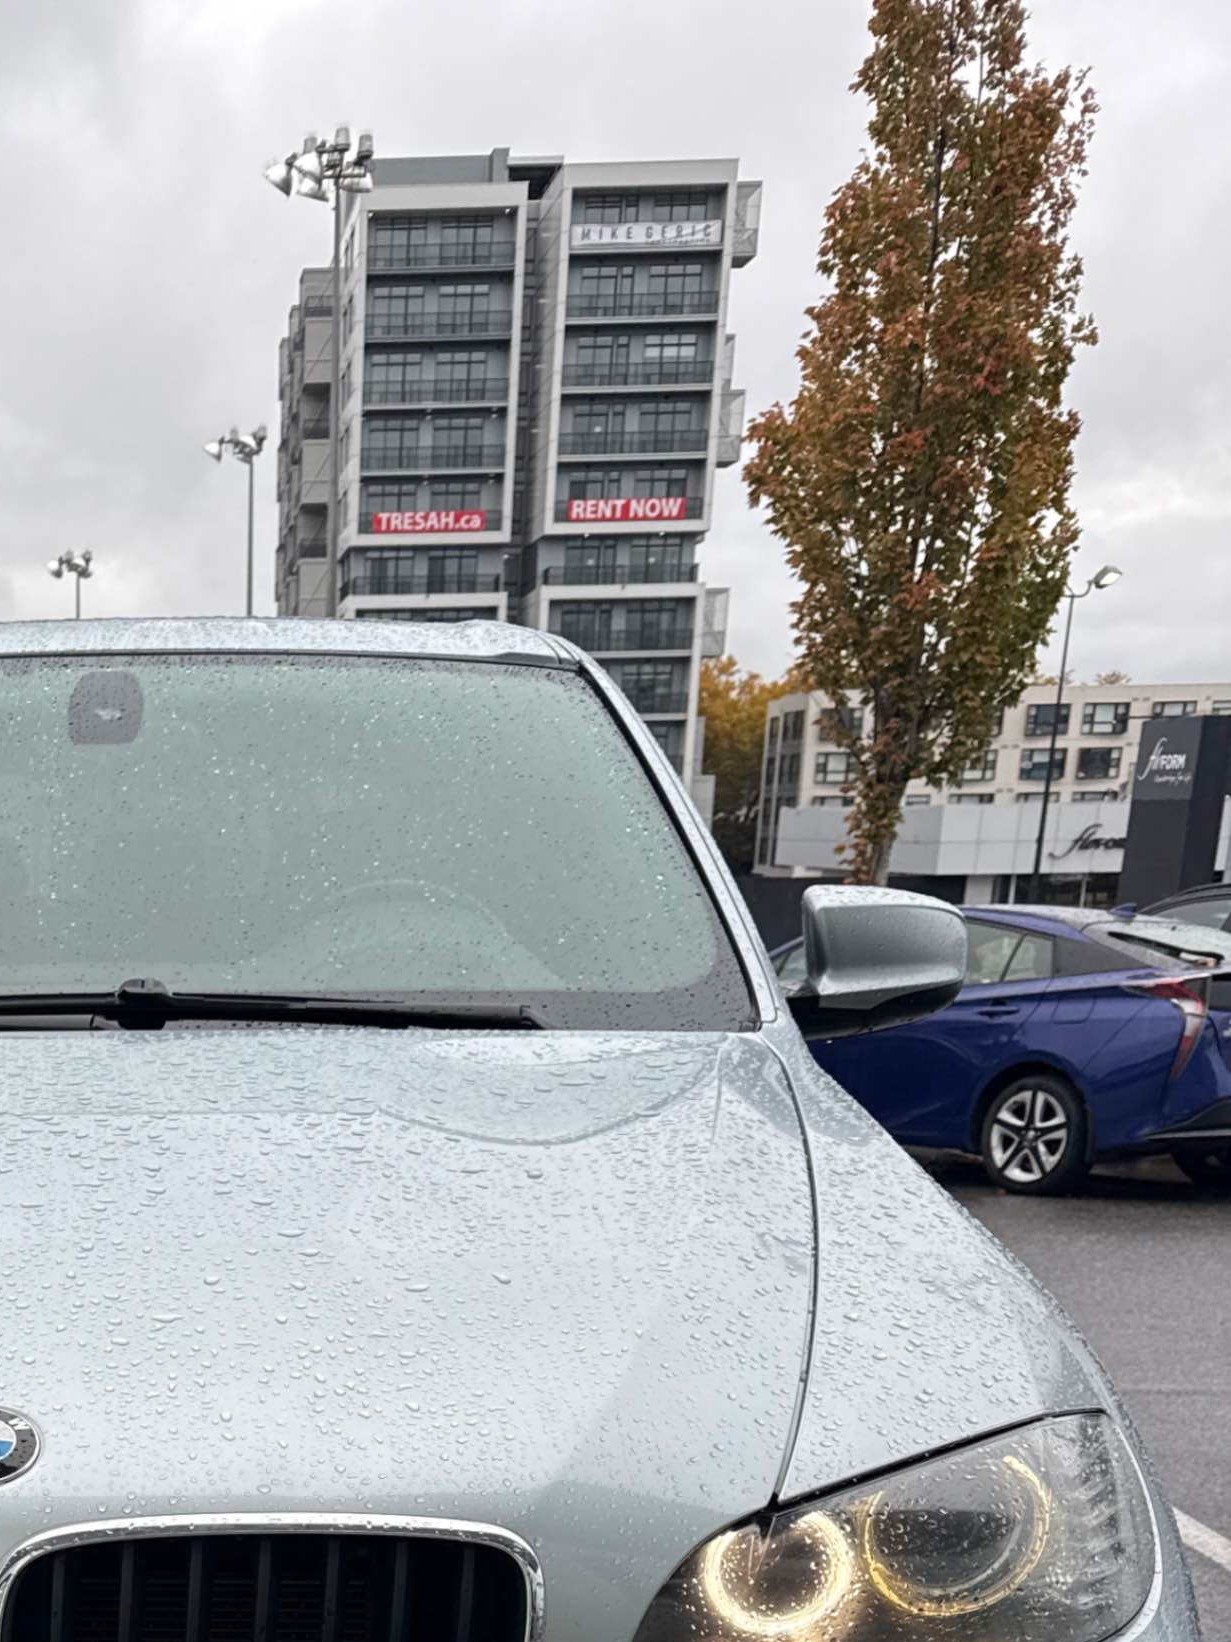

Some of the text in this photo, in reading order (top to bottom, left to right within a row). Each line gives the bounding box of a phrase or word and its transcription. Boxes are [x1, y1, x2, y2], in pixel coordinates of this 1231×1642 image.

[581, 226, 633, 241] MIKE
[571, 498, 683, 519] RENT NOW
[377, 511, 482, 532] TRESAH.ca
